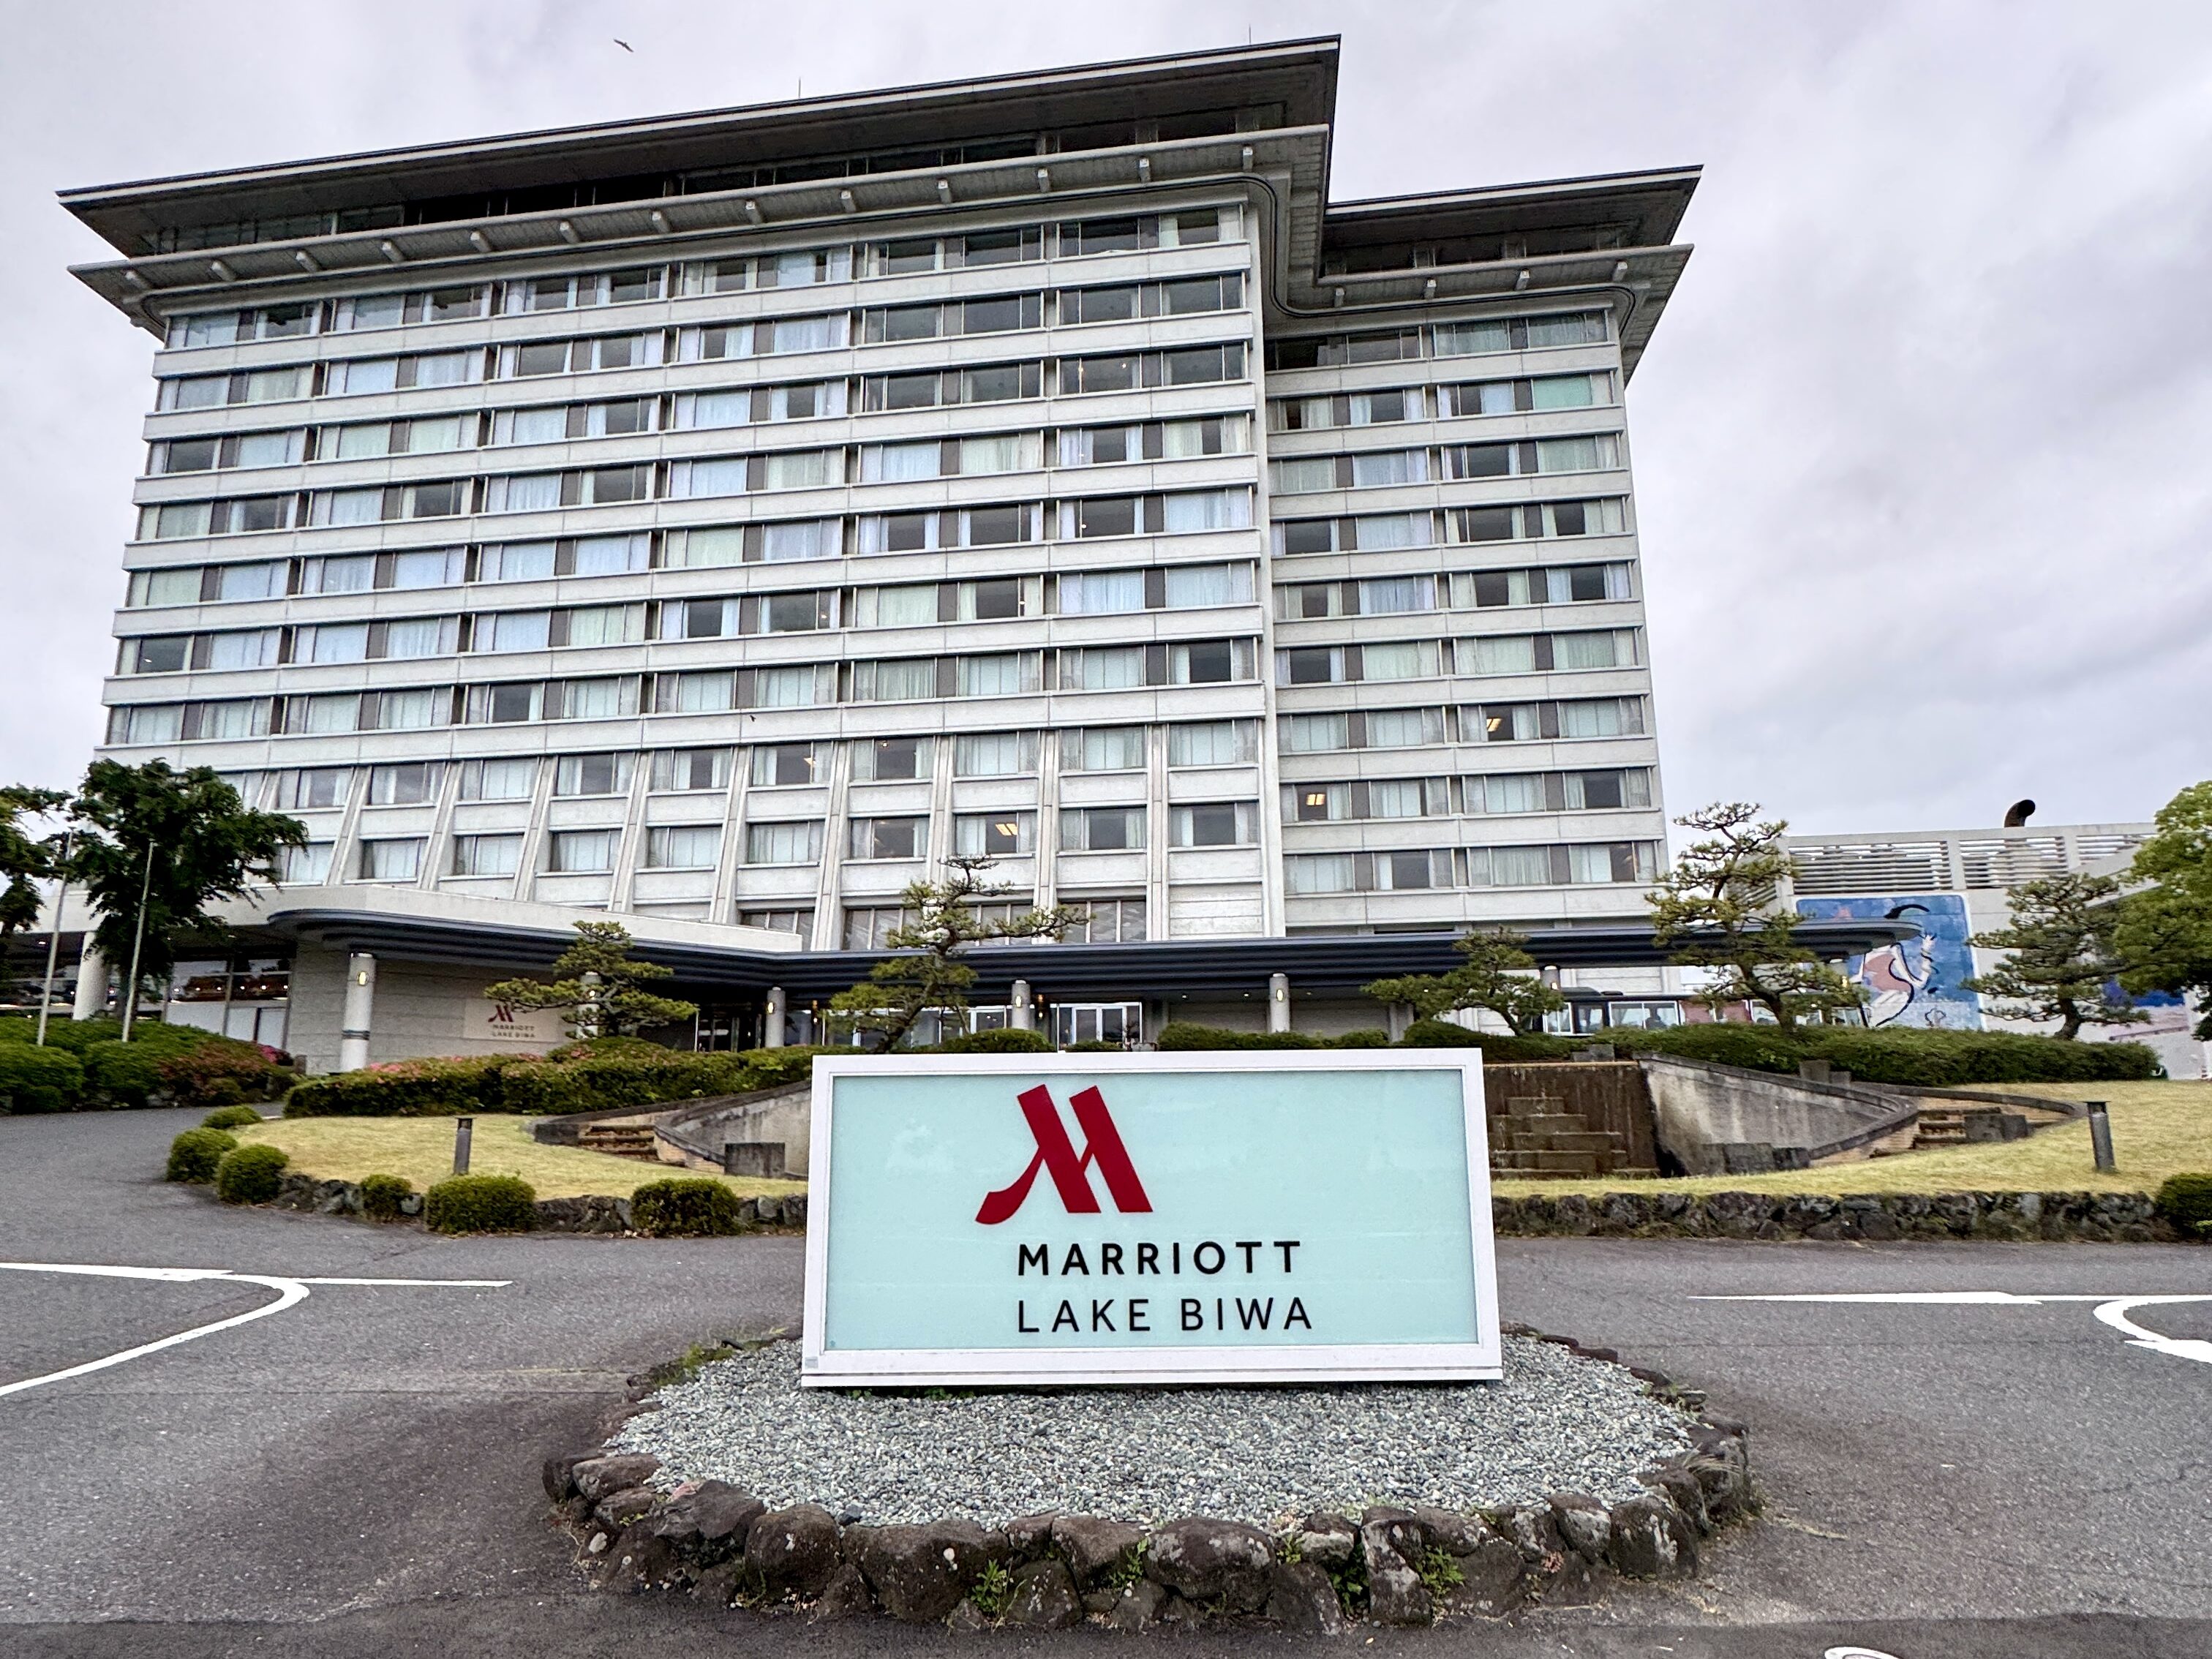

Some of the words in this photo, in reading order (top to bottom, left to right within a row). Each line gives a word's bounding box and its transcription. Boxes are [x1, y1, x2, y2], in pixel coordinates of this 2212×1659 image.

[1017, 1241, 1301, 1276] MARRIOTT
[1018, 1298, 1151, 1333] LAKE
[1181, 1297, 1312, 1331] BIWA
